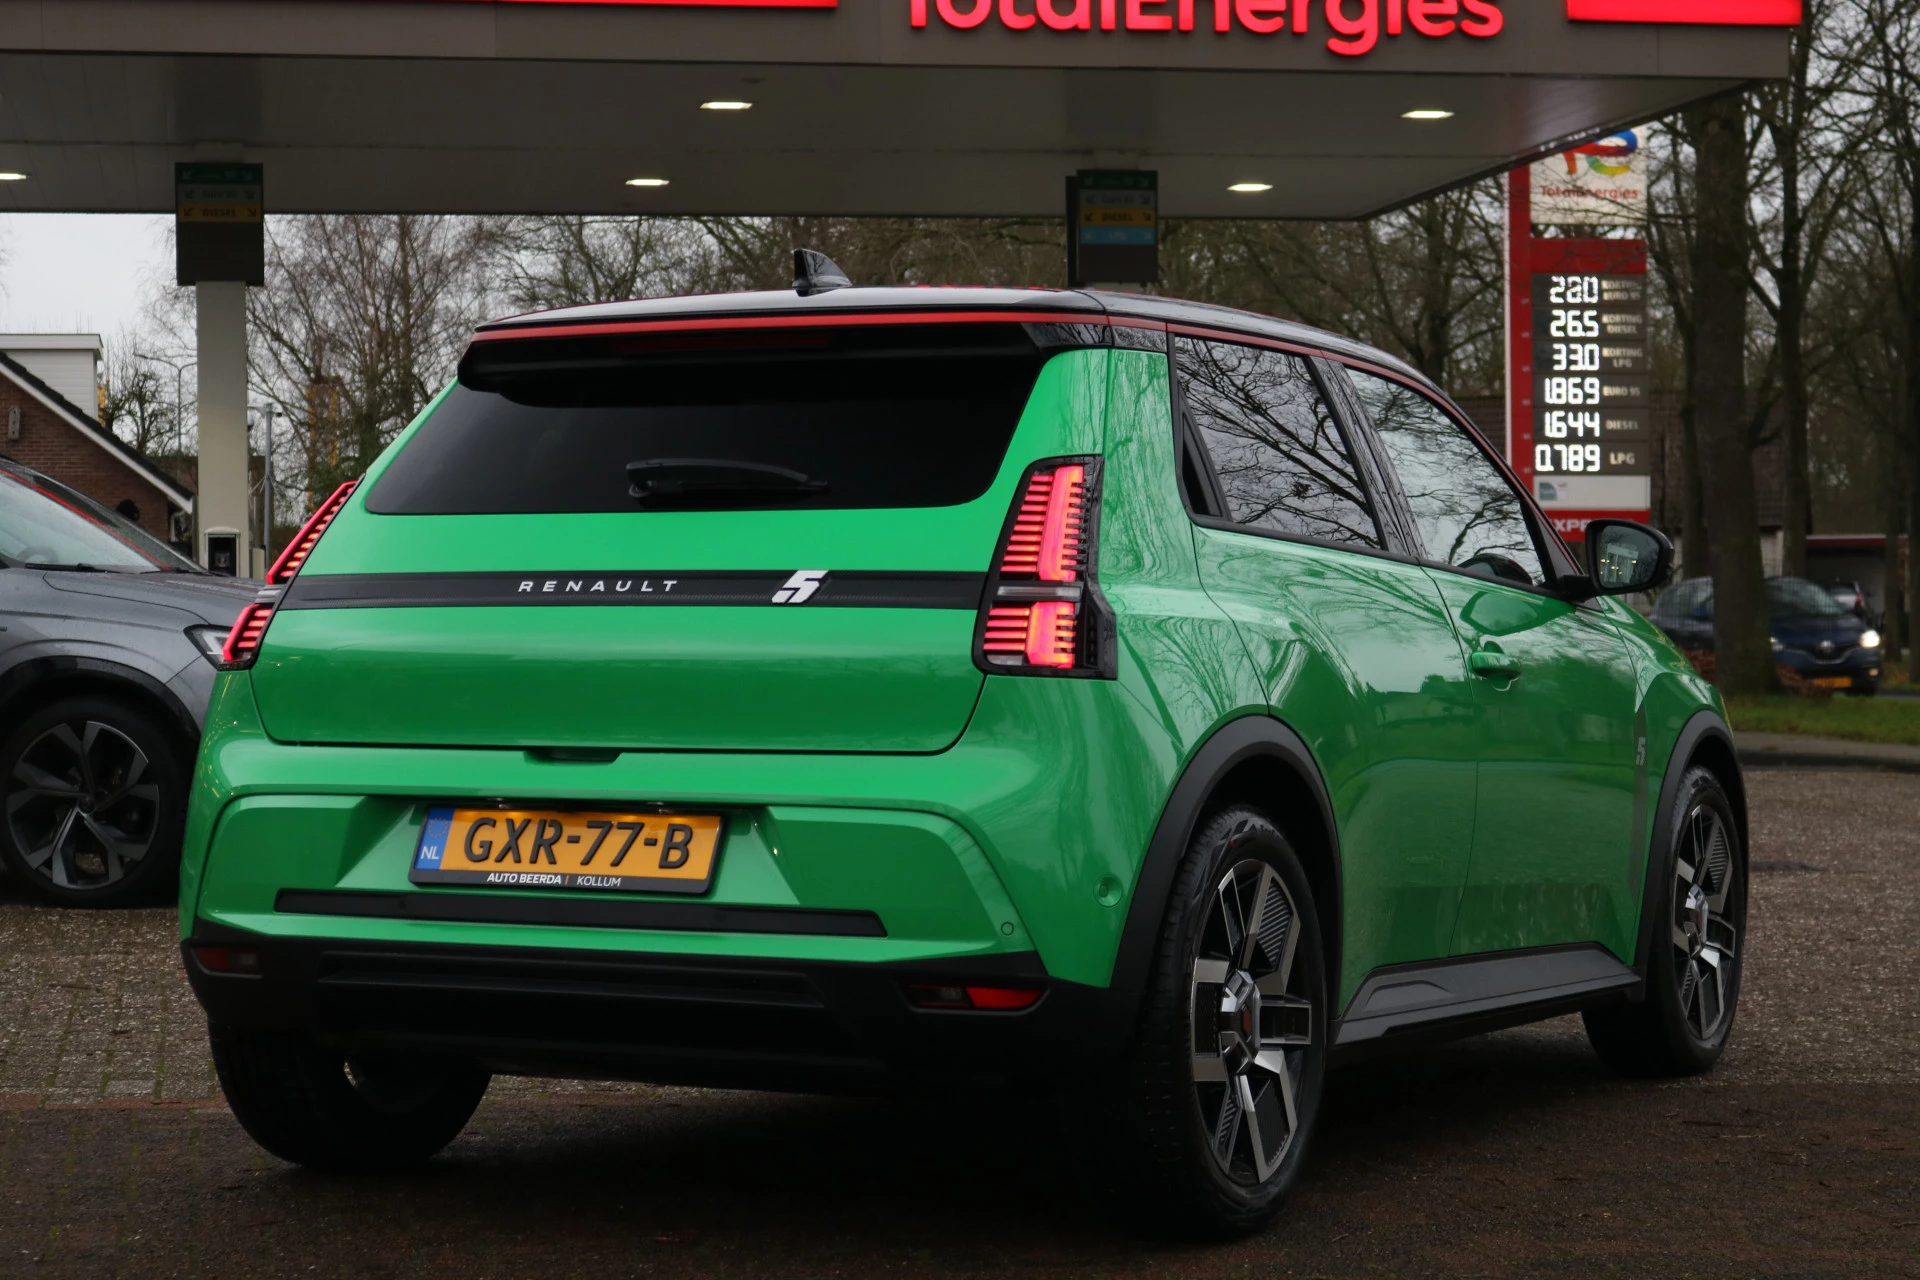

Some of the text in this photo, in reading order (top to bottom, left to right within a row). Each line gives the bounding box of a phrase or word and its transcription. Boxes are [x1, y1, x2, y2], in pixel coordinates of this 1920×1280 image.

[1601, 313, 1643, 324] KORTING
[1606, 324, 1637, 334] DIESEL
[1602, 347, 1643, 357] KORTING
[1613, 358, 1633, 368] LPG
[1602, 386, 1641, 396] EURO 95
[1605, 419, 1639, 430] DIESEL
[1609, 451, 1636, 465] LPG
[517, 580, 678, 593] RENAULT
[463, 817, 694, 869] GXR-77-B
[420, 845, 440, 860] NL
[487, 872, 622, 887] AUTO BEERDA KOLLUM
